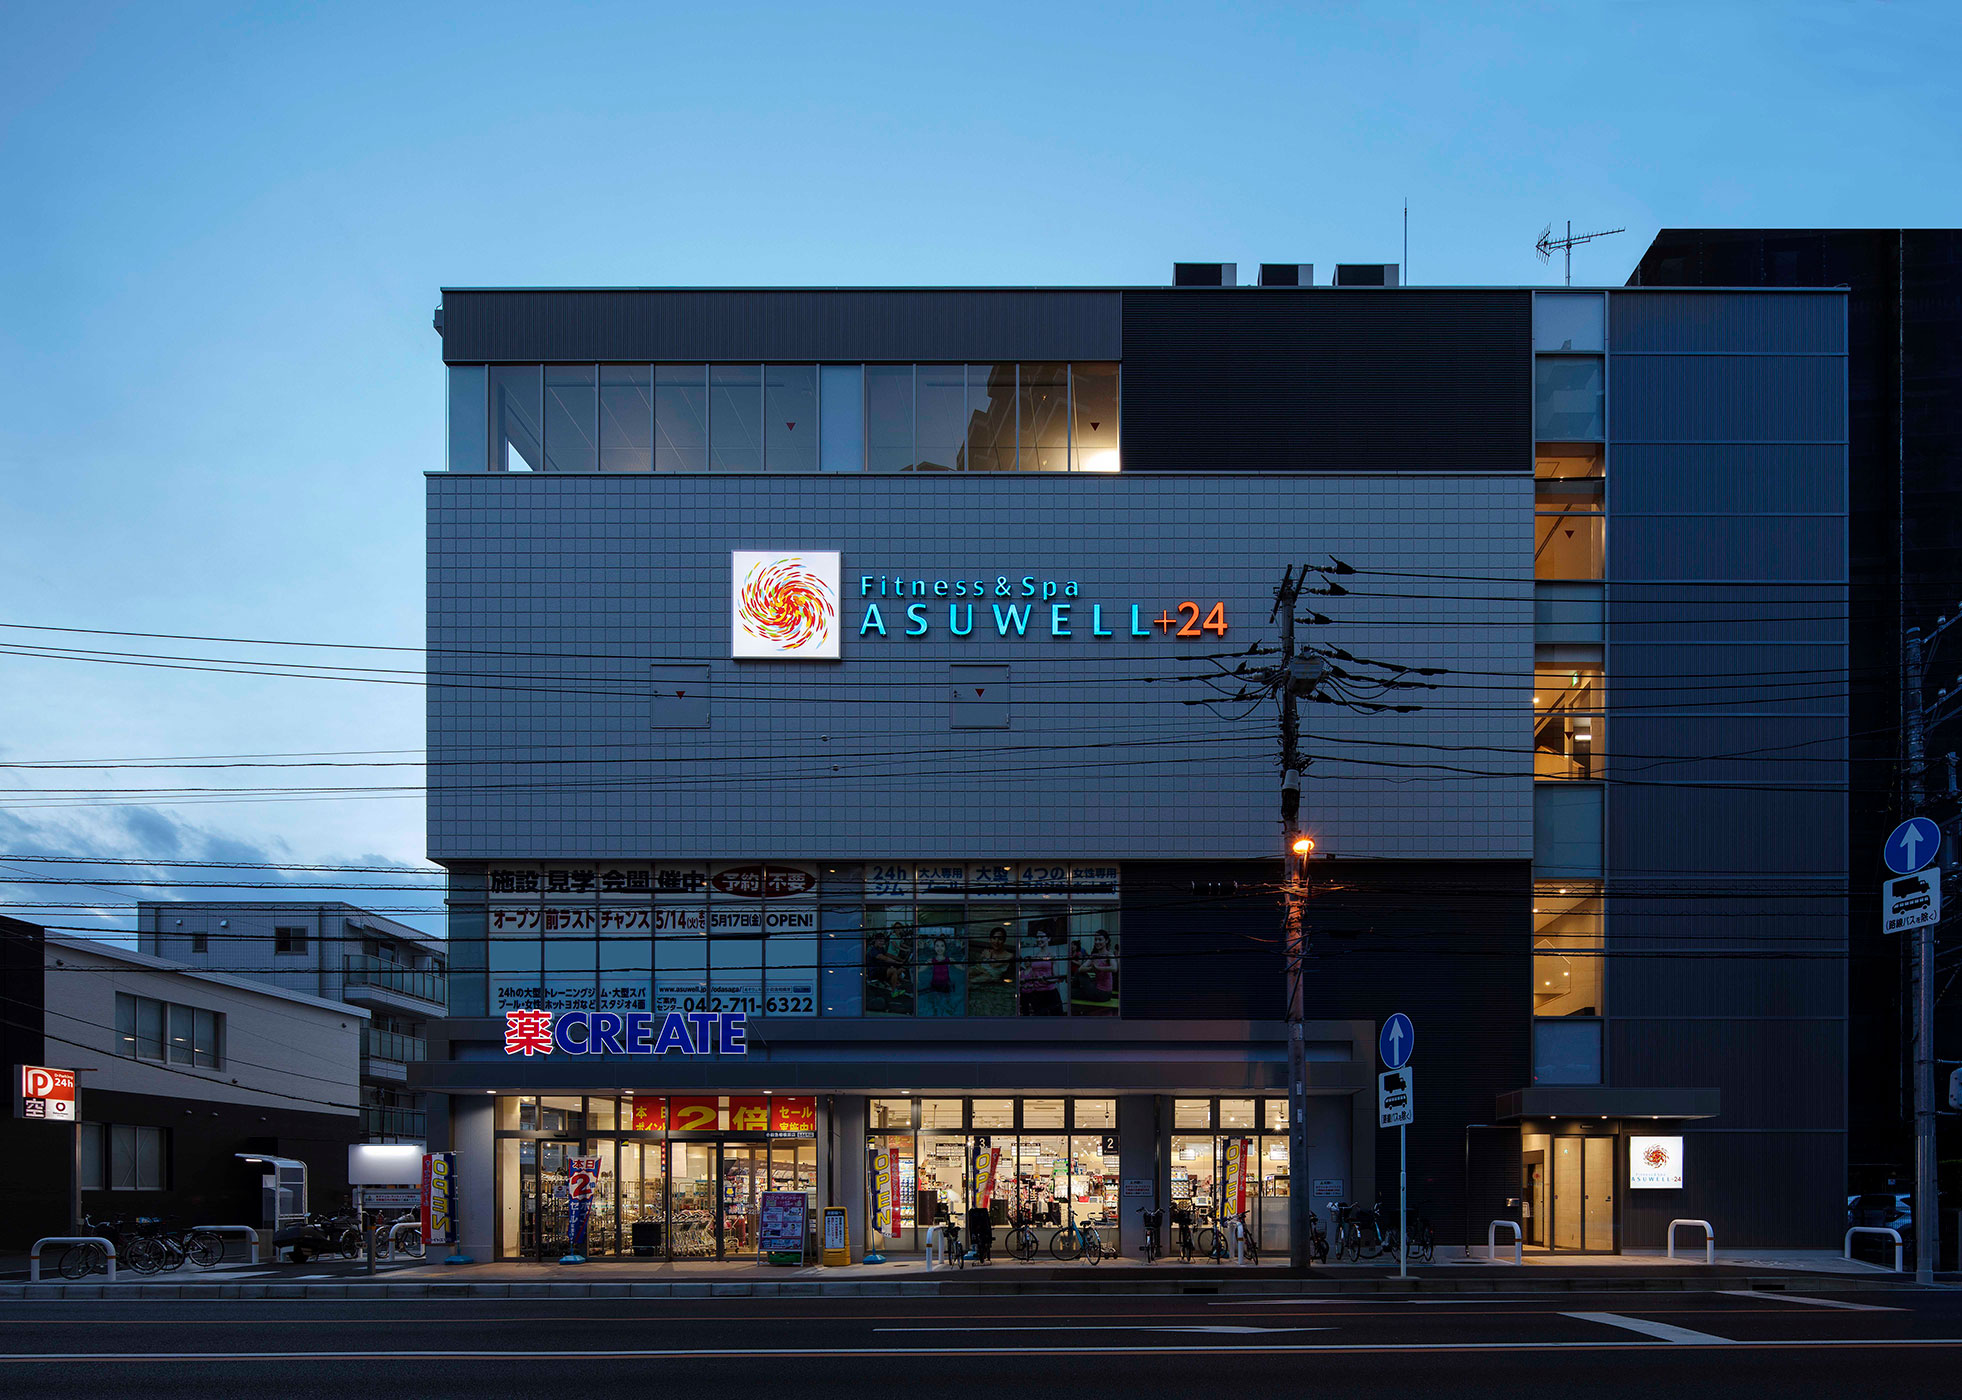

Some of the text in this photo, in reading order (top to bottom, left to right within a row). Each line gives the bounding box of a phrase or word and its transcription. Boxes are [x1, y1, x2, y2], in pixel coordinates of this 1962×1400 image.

[860, 575, 1080, 601] Fitness&Spa
[873, 866, 906, 881] 24h
[919, 867, 962, 879] 大人専用
[976, 865, 1009, 881] 大型
[1022, 866, 1065, 880] 4つの
[1073, 867, 1117, 879] 女性専用
[721, 872, 806, 892] 予約不要
[683, 997, 813, 1012] 042-711-6322
[504, 1009, 747, 1056] 薬 CREATE
[54, 1078, 73, 1088] 24h
[25, 1098, 45, 1117] 空
[779, 1105, 813, 1119] セール
[1107, 1137, 1114, 1149] 2
[573, 1159, 595, 1169] 本日
[1223, 1144, 1240, 1217] OPEN
[874, 1153, 891, 1228] OPEN
